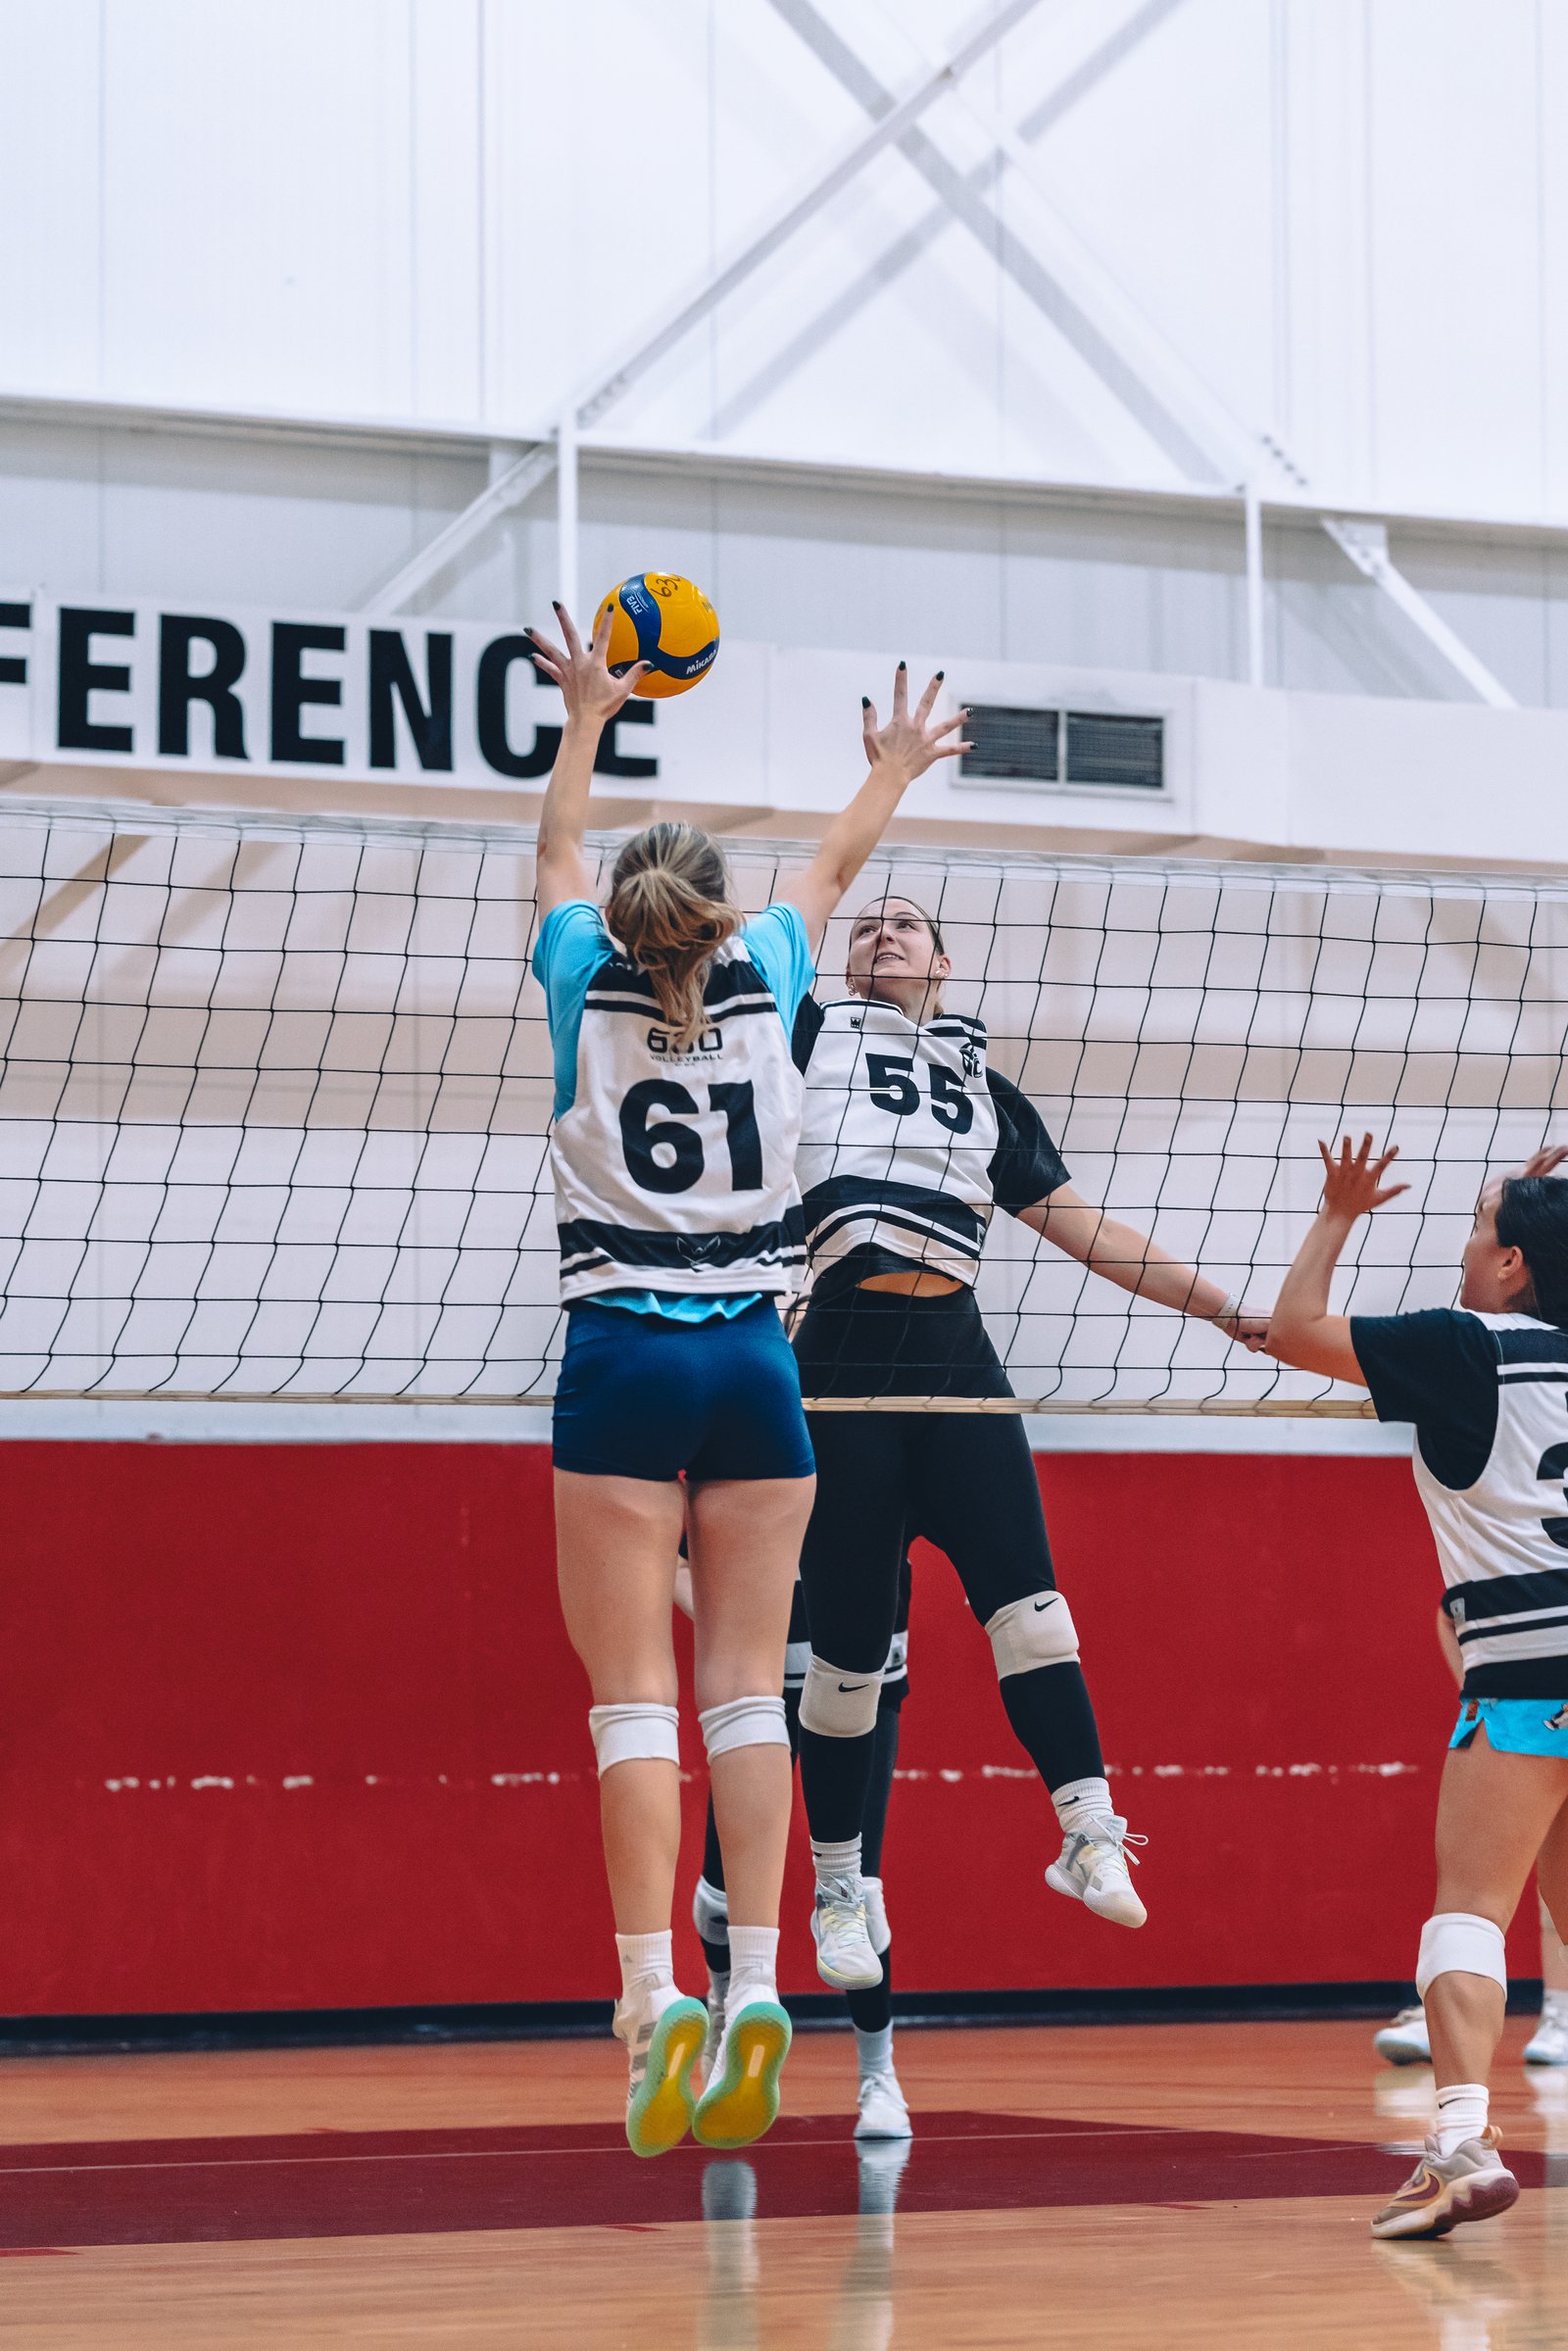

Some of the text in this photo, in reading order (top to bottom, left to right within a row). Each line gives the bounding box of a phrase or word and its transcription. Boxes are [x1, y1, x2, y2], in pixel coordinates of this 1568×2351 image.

[626, 595, 643, 615] FIVB
[650, 1053, 724, 1062] VOLLEYBALL
[865, 1053, 973, 1135] 55
[619, 1079, 762, 1194] 61
